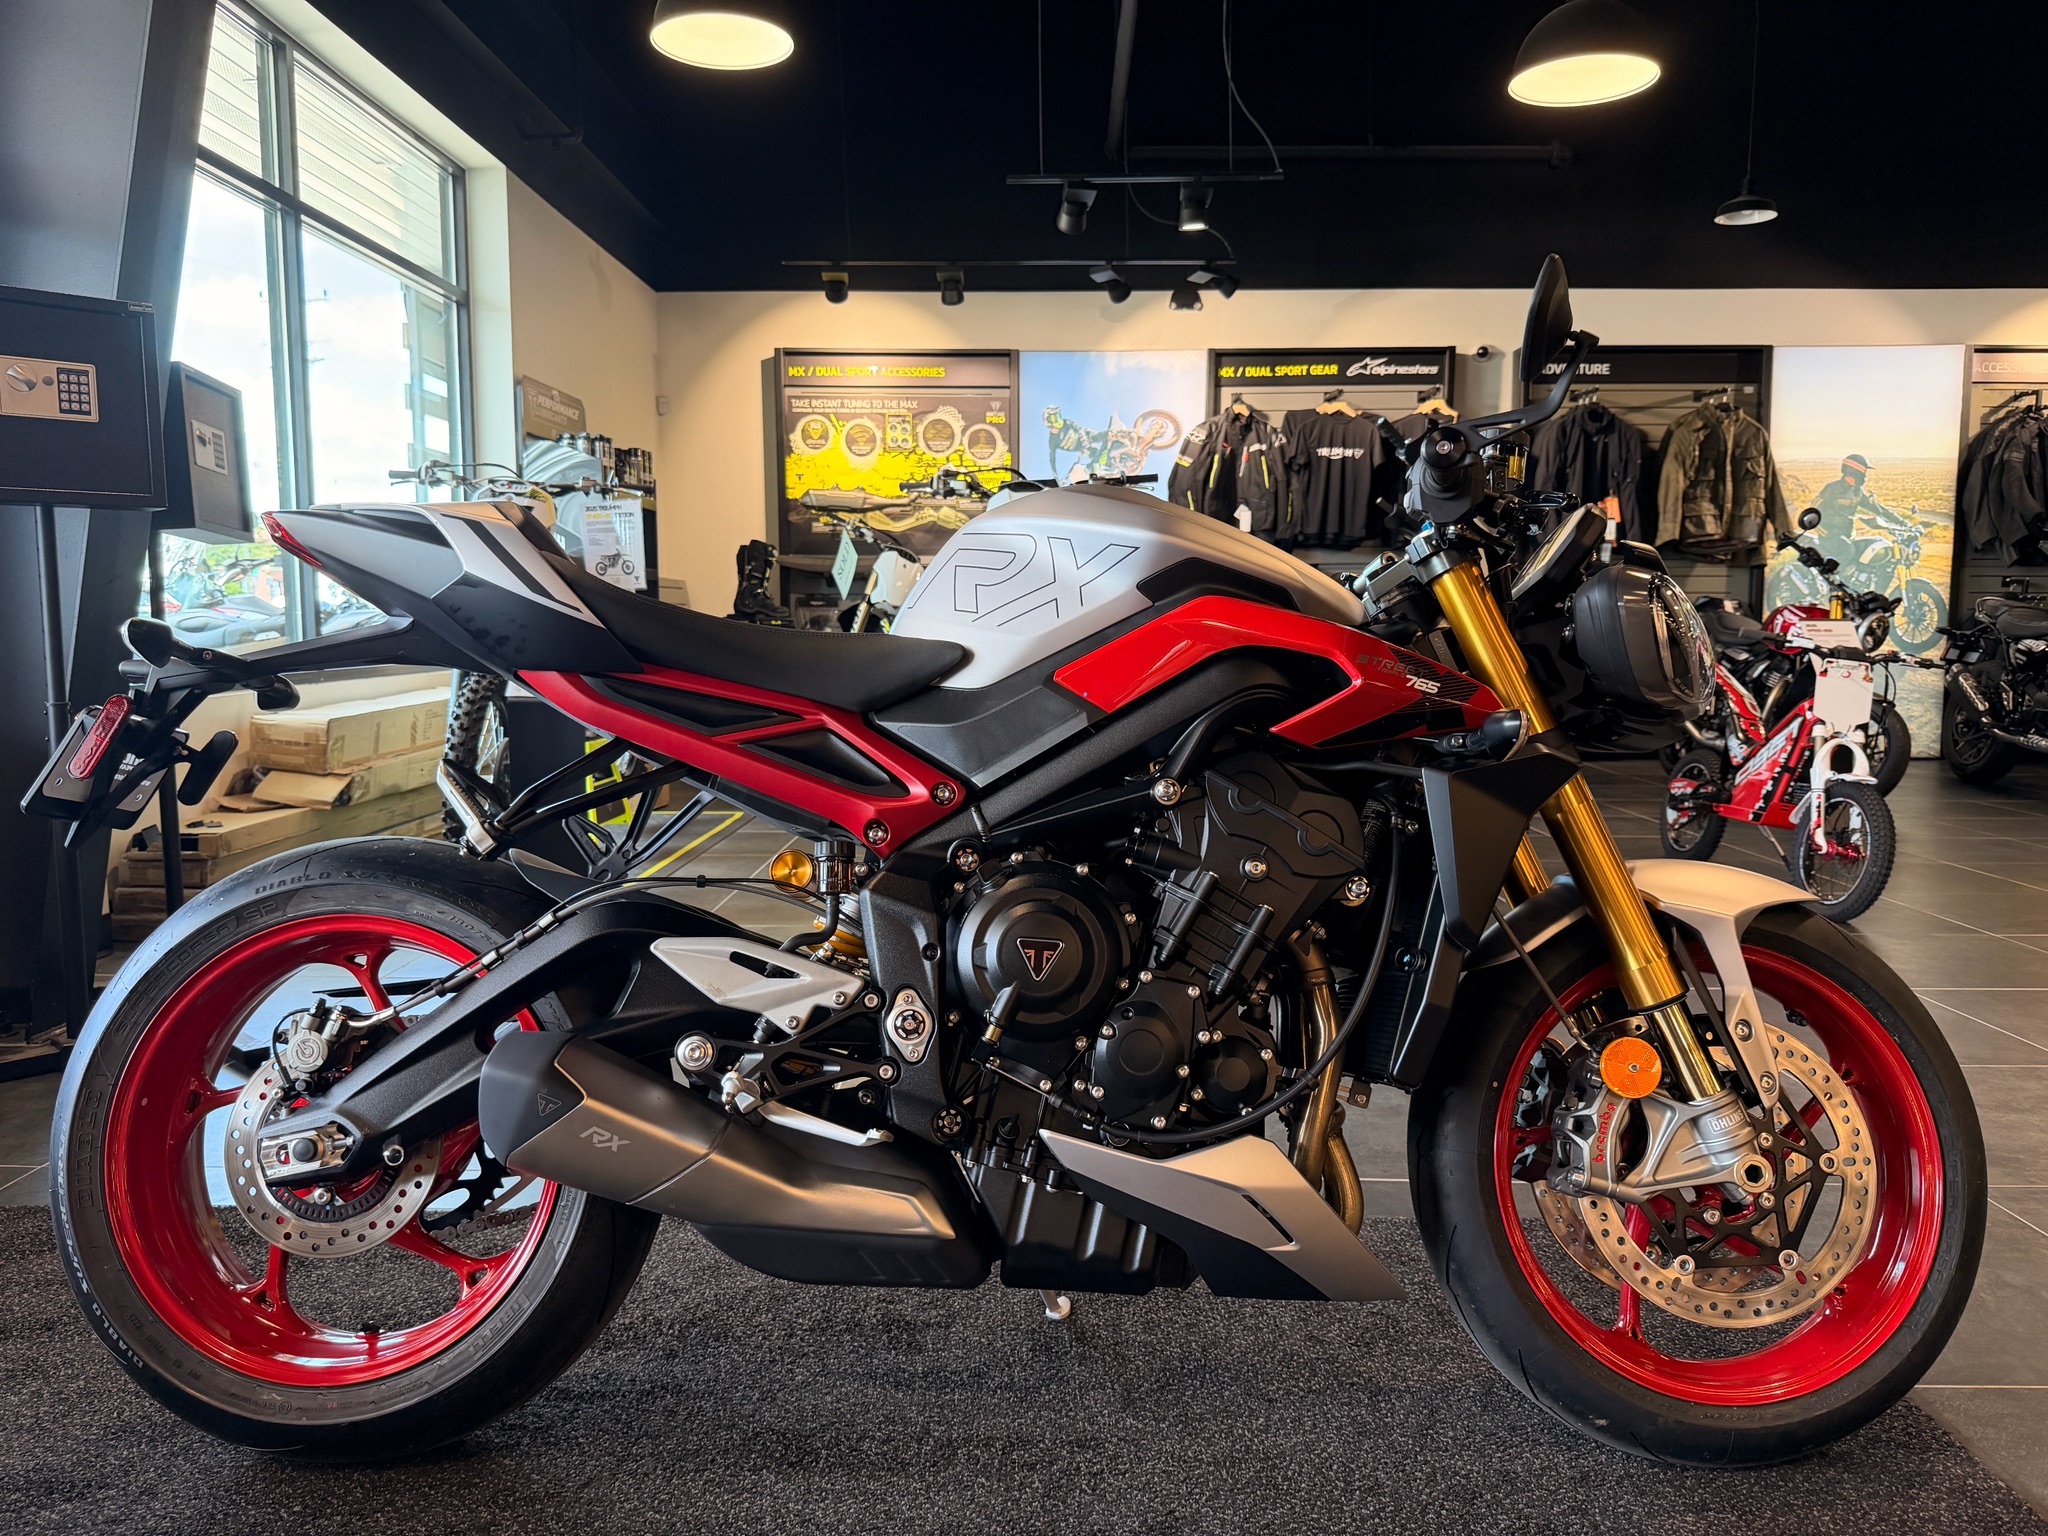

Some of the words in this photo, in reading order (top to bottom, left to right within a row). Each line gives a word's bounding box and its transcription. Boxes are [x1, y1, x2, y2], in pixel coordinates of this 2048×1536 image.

[788, 365, 805, 377] MX
[807, 366, 814, 377] /
[815, 366, 843, 377] DUAL
[845, 365, 878, 378] SPORT
[880, 366, 945, 378] ACCESSORIES
[1236, 365, 1243, 377] /
[1245, 364, 1273, 377] DUAL
[1275, 364, 1307, 376] SPORT
[1309, 364, 1338, 375] GEAR
[1371, 363, 1440, 376] alpinestars
[1542, 363, 1611, 375] DVTURE
[537, 394, 580, 420] PERFORMANCE
[790, 399, 810, 408] TAKE
[811, 400, 841, 409] INSTANT
[843, 400, 870, 409] TUNING
[872, 400, 882, 409] TO
[884, 400, 898, 409] THE
[899, 400, 918, 409] MAX
[985, 415, 1006, 424] PRO
[1315, 446, 1354, 460] TRIUMH
[598, 503, 622, 512] TRIUMPH
[907, 532, 1142, 627] RX
[1355, 653, 1427, 689] STREET
[1406, 674, 1441, 694] 765
[255, 871, 332, 895] DIABLO
[115, 924, 232, 1036] SUPERCORSA
[243, 901, 278, 922] SP
[1712, 1108, 1744, 1132] ÖHLINS
[579, 1126, 631, 1152] RX
[1593, 1102, 1616, 1163] brembo
[77, 1088, 102, 1209] DIABLO
[92, 1302, 144, 1369] DIABLO
